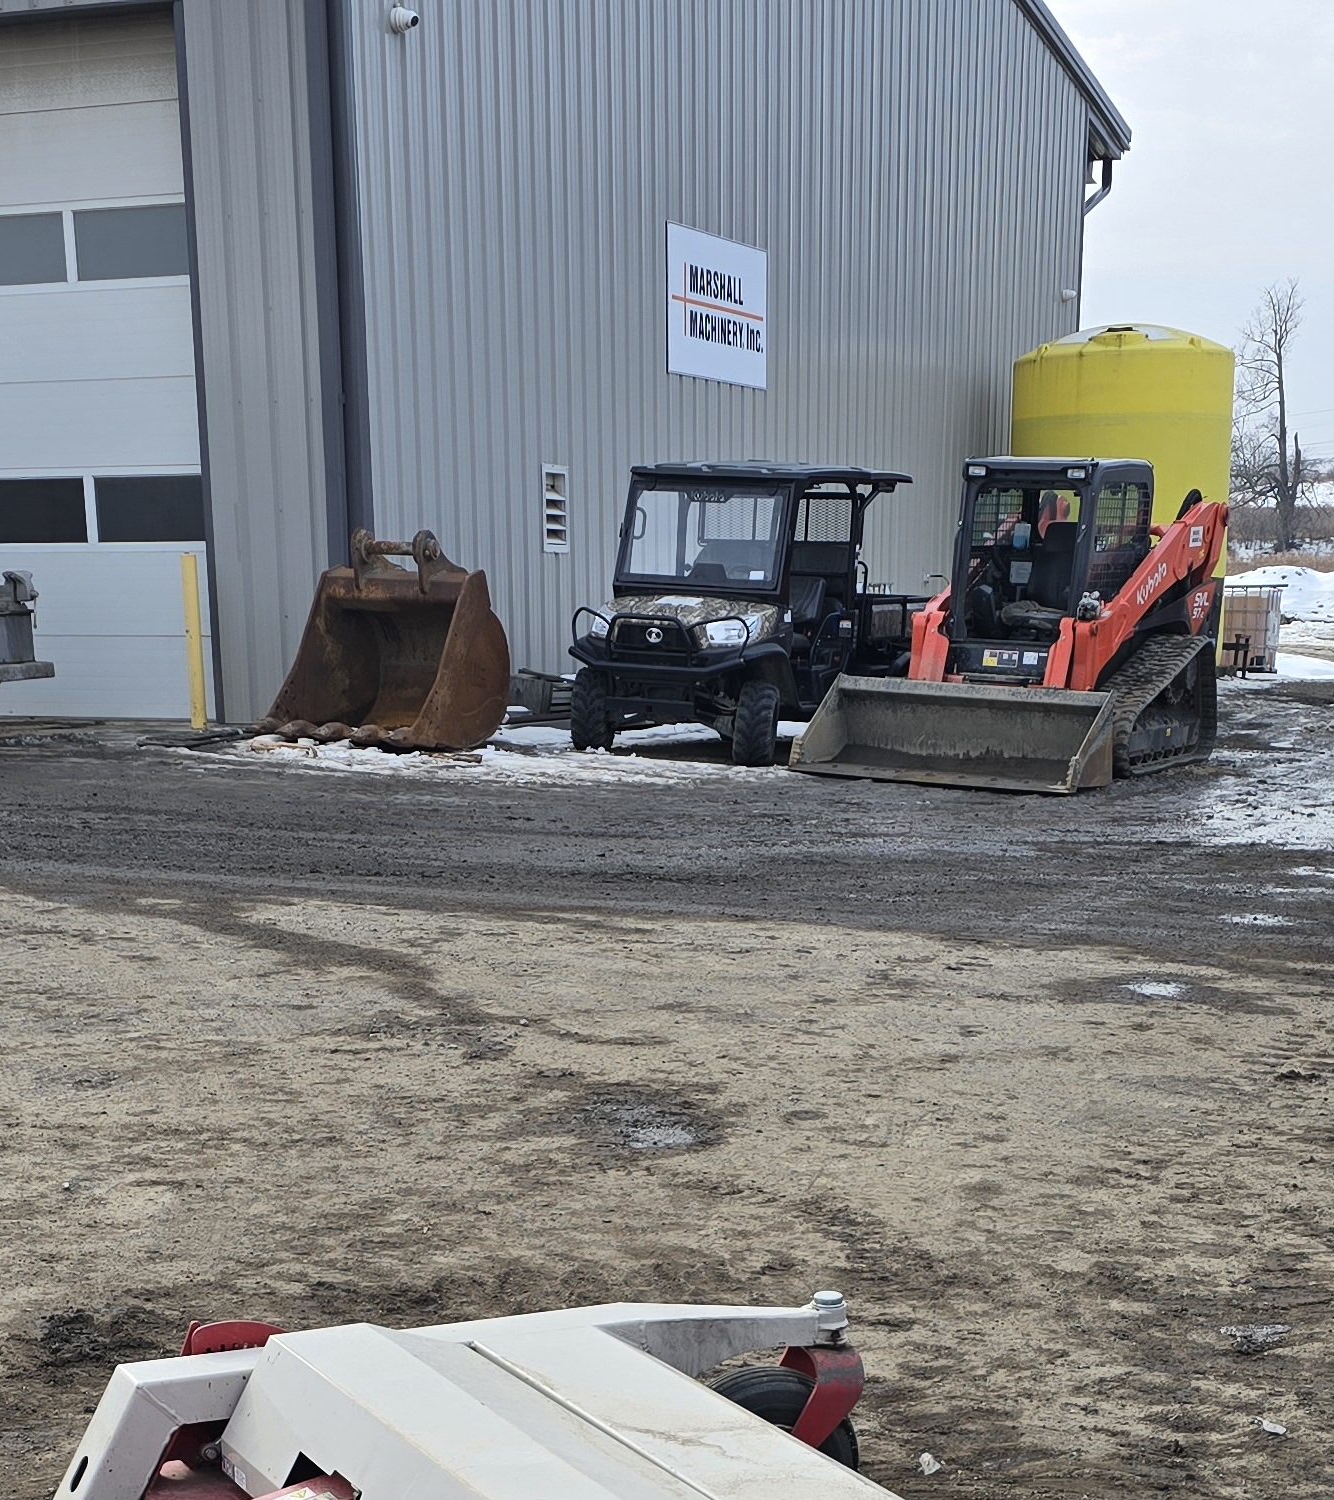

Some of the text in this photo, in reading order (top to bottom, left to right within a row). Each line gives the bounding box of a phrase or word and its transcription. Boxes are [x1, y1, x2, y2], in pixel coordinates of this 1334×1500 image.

[689, 264, 744, 306] MARSHALL
[689, 309, 764, 354] MACHINERY, Inc.
[1137, 563, 1167, 605] Kubota
[1194, 592, 1209, 606] SVL
